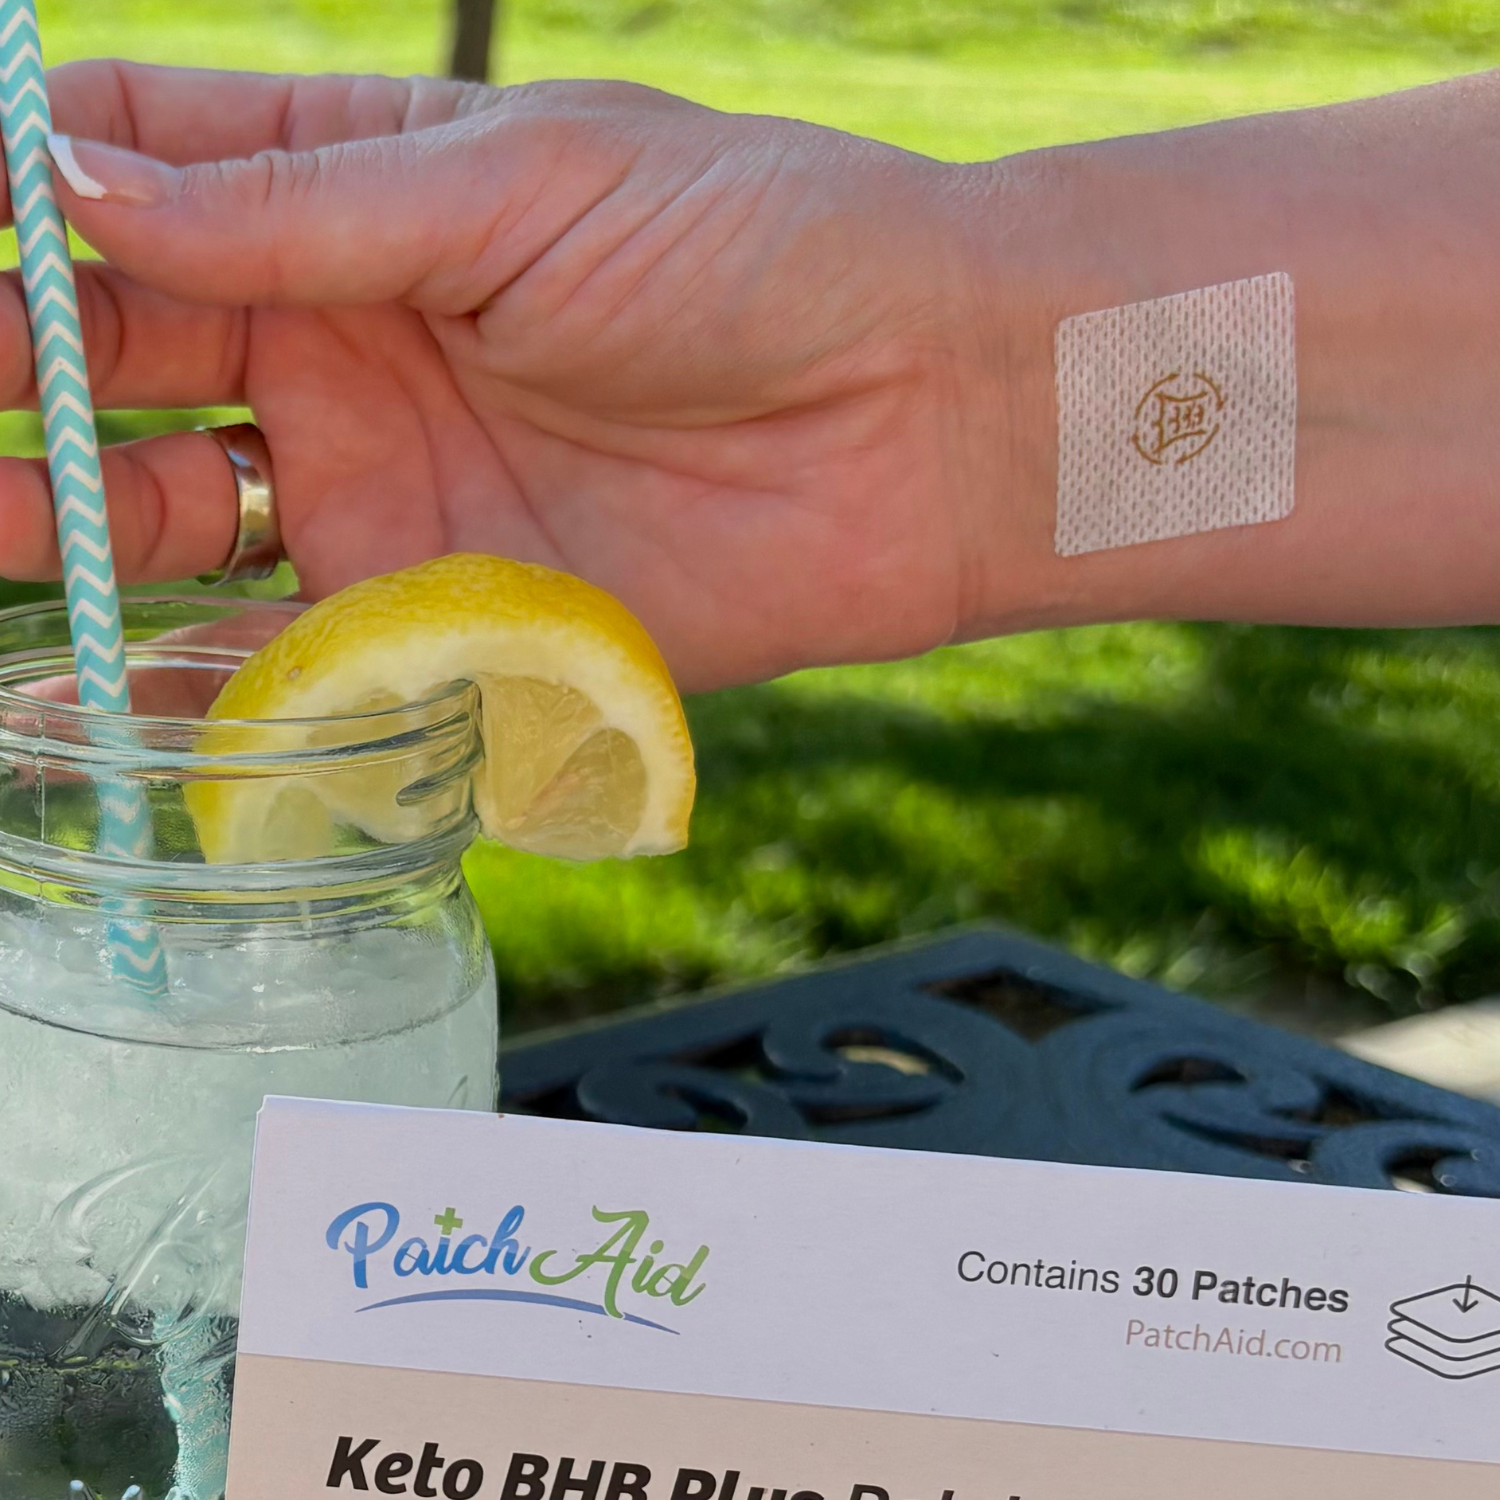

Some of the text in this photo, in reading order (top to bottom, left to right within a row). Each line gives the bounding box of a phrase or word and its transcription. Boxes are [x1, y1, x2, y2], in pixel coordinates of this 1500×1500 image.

[957, 1250, 1350, 1314] Contains 30 Patches
[1125, 1318, 1342, 1364] PatchAid.com
